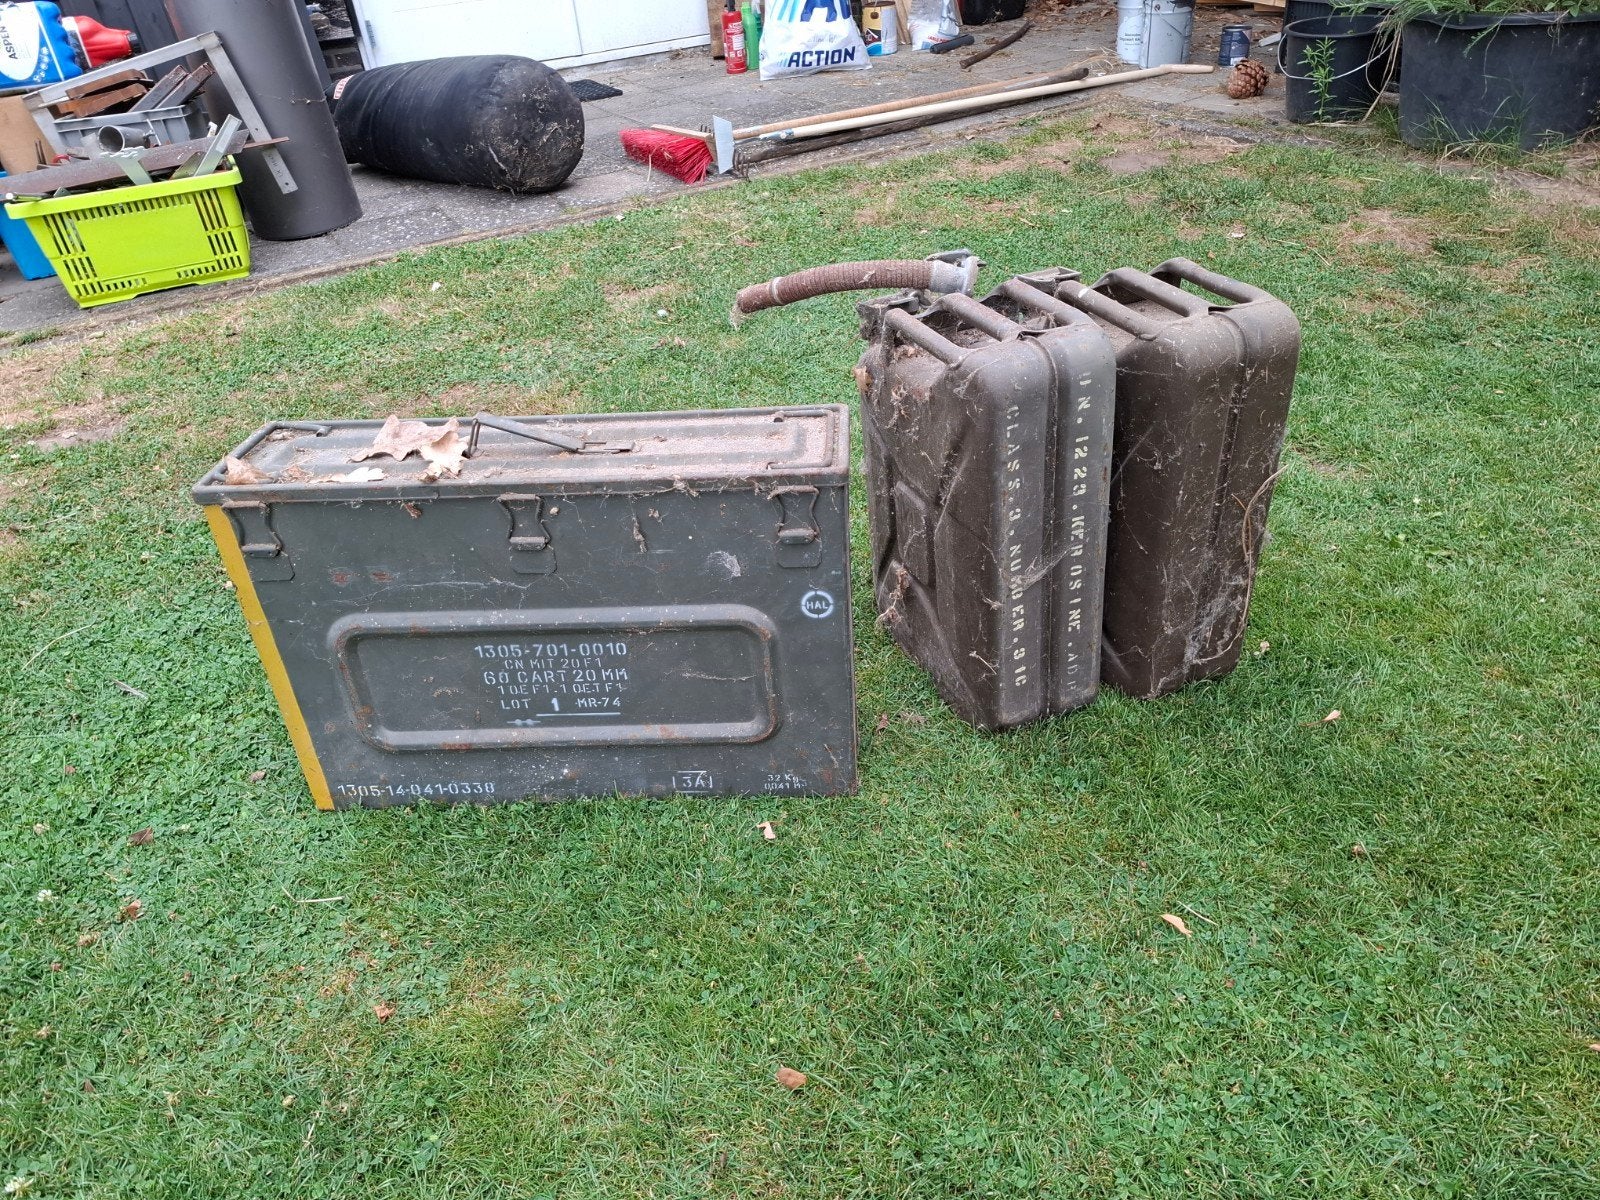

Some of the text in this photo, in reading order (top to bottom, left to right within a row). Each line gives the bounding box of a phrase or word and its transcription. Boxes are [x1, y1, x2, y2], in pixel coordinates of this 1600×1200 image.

[0, 26, 18, 60] ASPEN
[787, 46, 856, 68] ACTION
[806, 600, 829, 610] HAL
[474, 642, 627, 658] 1305-701-0010
[504, 659, 524, 670] CN
[517, 670, 567, 684] CART
[572, 669, 596, 682] 20
[601, 667, 629, 682] MM
[500, 698, 531, 709] LOT
[551, 697, 560, 712] 1
